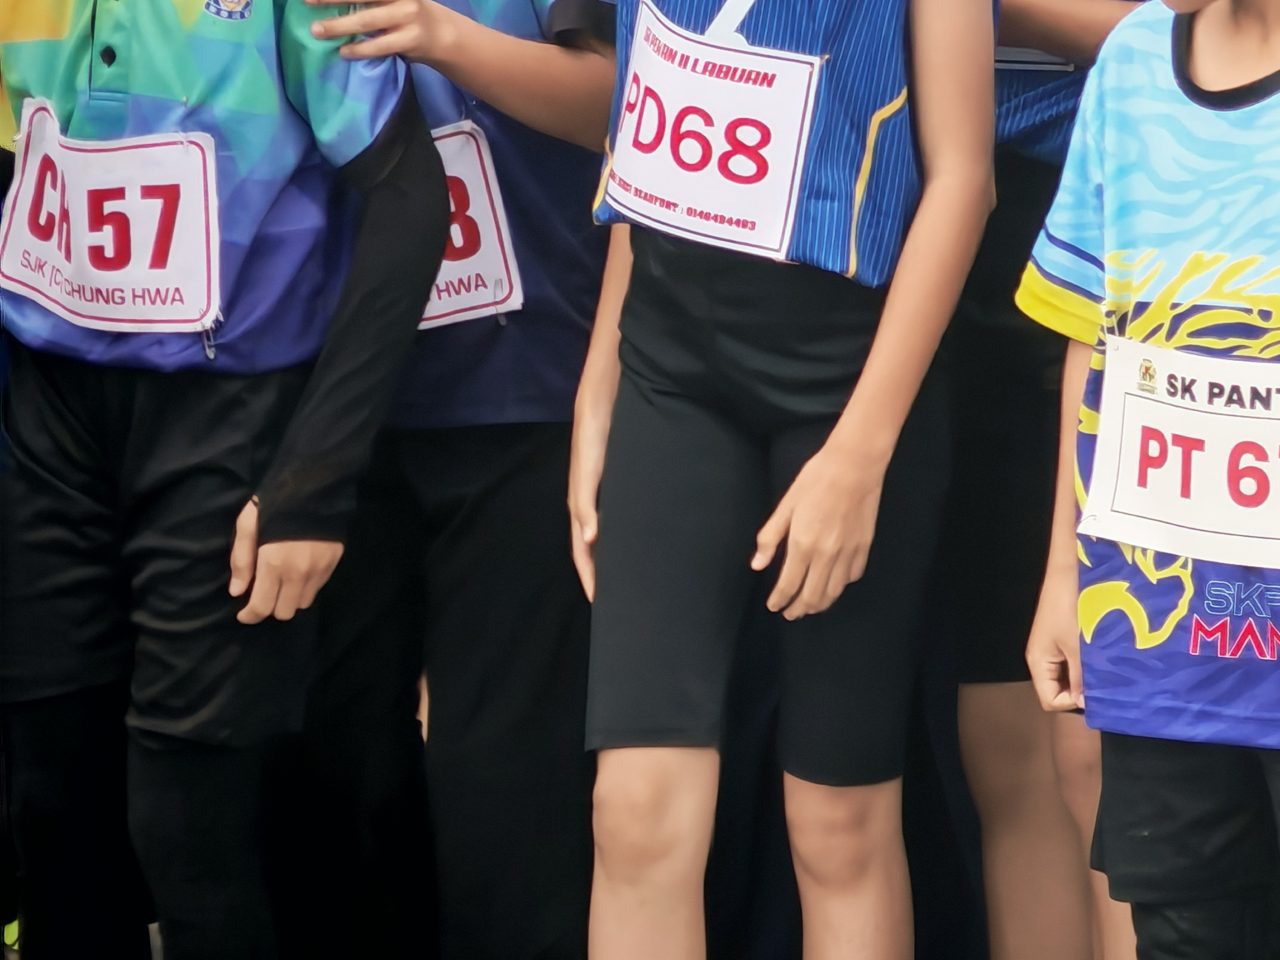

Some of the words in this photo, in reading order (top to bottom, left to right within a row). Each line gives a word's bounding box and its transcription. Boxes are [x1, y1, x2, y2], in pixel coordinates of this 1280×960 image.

[691, 58, 777, 88] LABUAN
[619, 71, 772, 185] PD68
[28, 153, 72, 264] CH
[87, 183, 181, 272] 57
[20, 249, 46, 279] SJK
[131, 286, 185, 306] HWA
[435, 272, 488, 301] HWA
[1166, 373, 1198, 403] SK
[1137, 424, 1206, 500] PT
